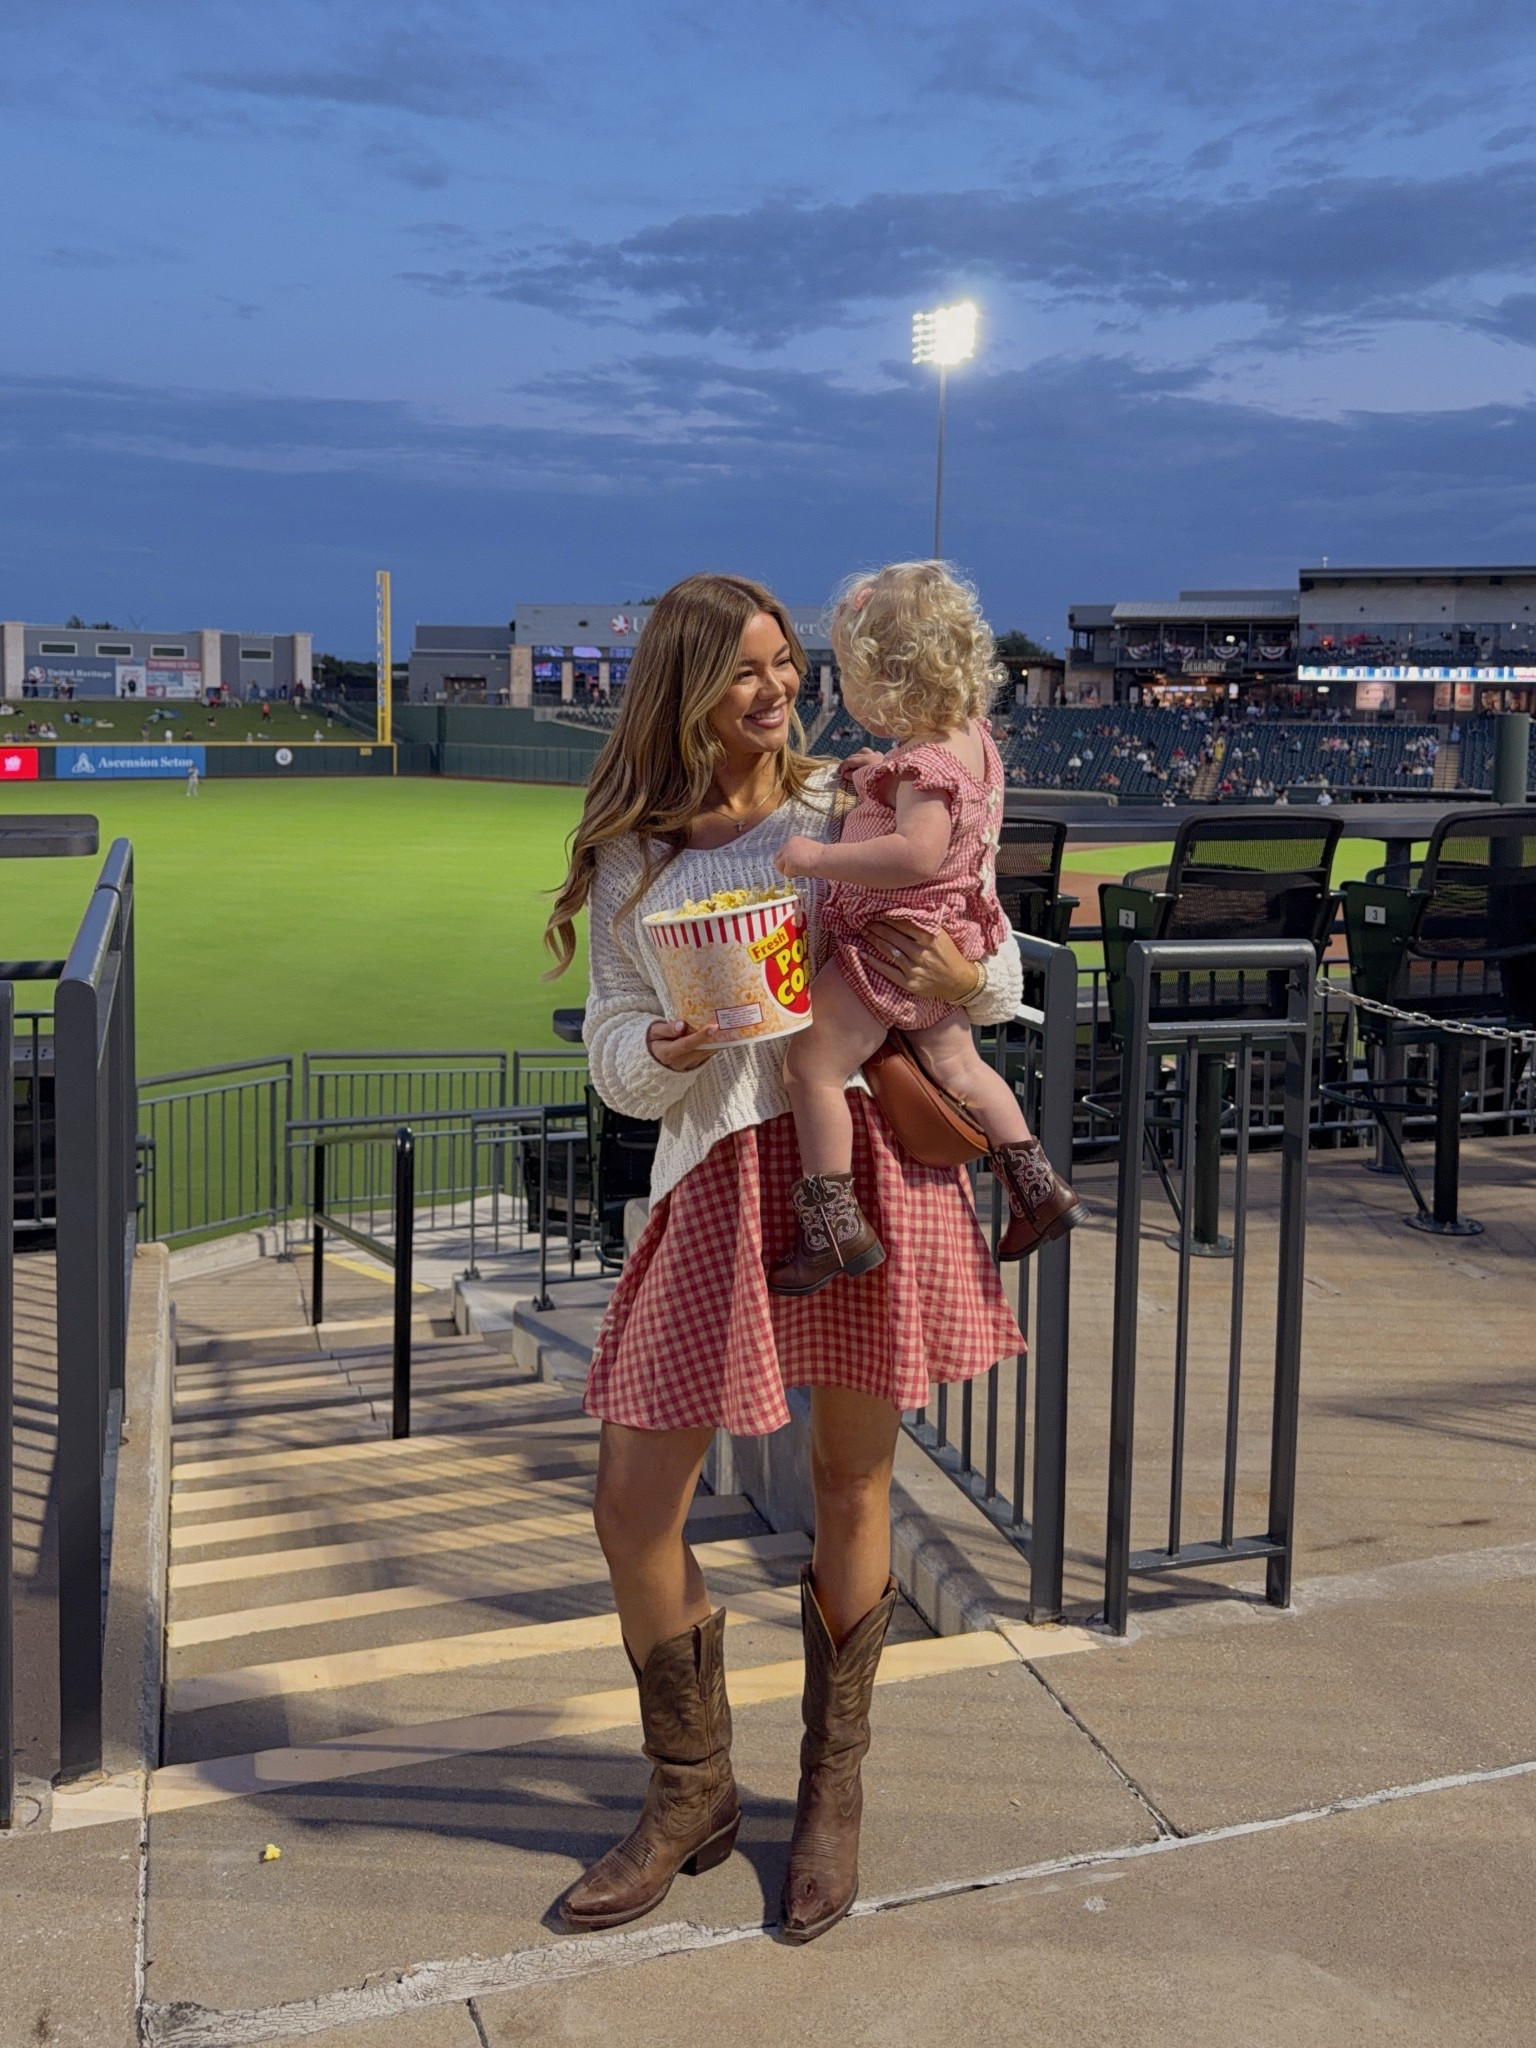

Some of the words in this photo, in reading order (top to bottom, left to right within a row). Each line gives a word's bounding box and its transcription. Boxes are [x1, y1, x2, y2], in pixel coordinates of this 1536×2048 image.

[47, 668, 75, 677] United
[76, 669, 112, 679] Heritage
[98, 757, 159, 769] Ascension
[160, 756, 193, 768] Seton
[1125, 912, 1130, 925] 2
[1372, 909, 1378, 921] 3
[751, 931, 787, 960] Fresh
